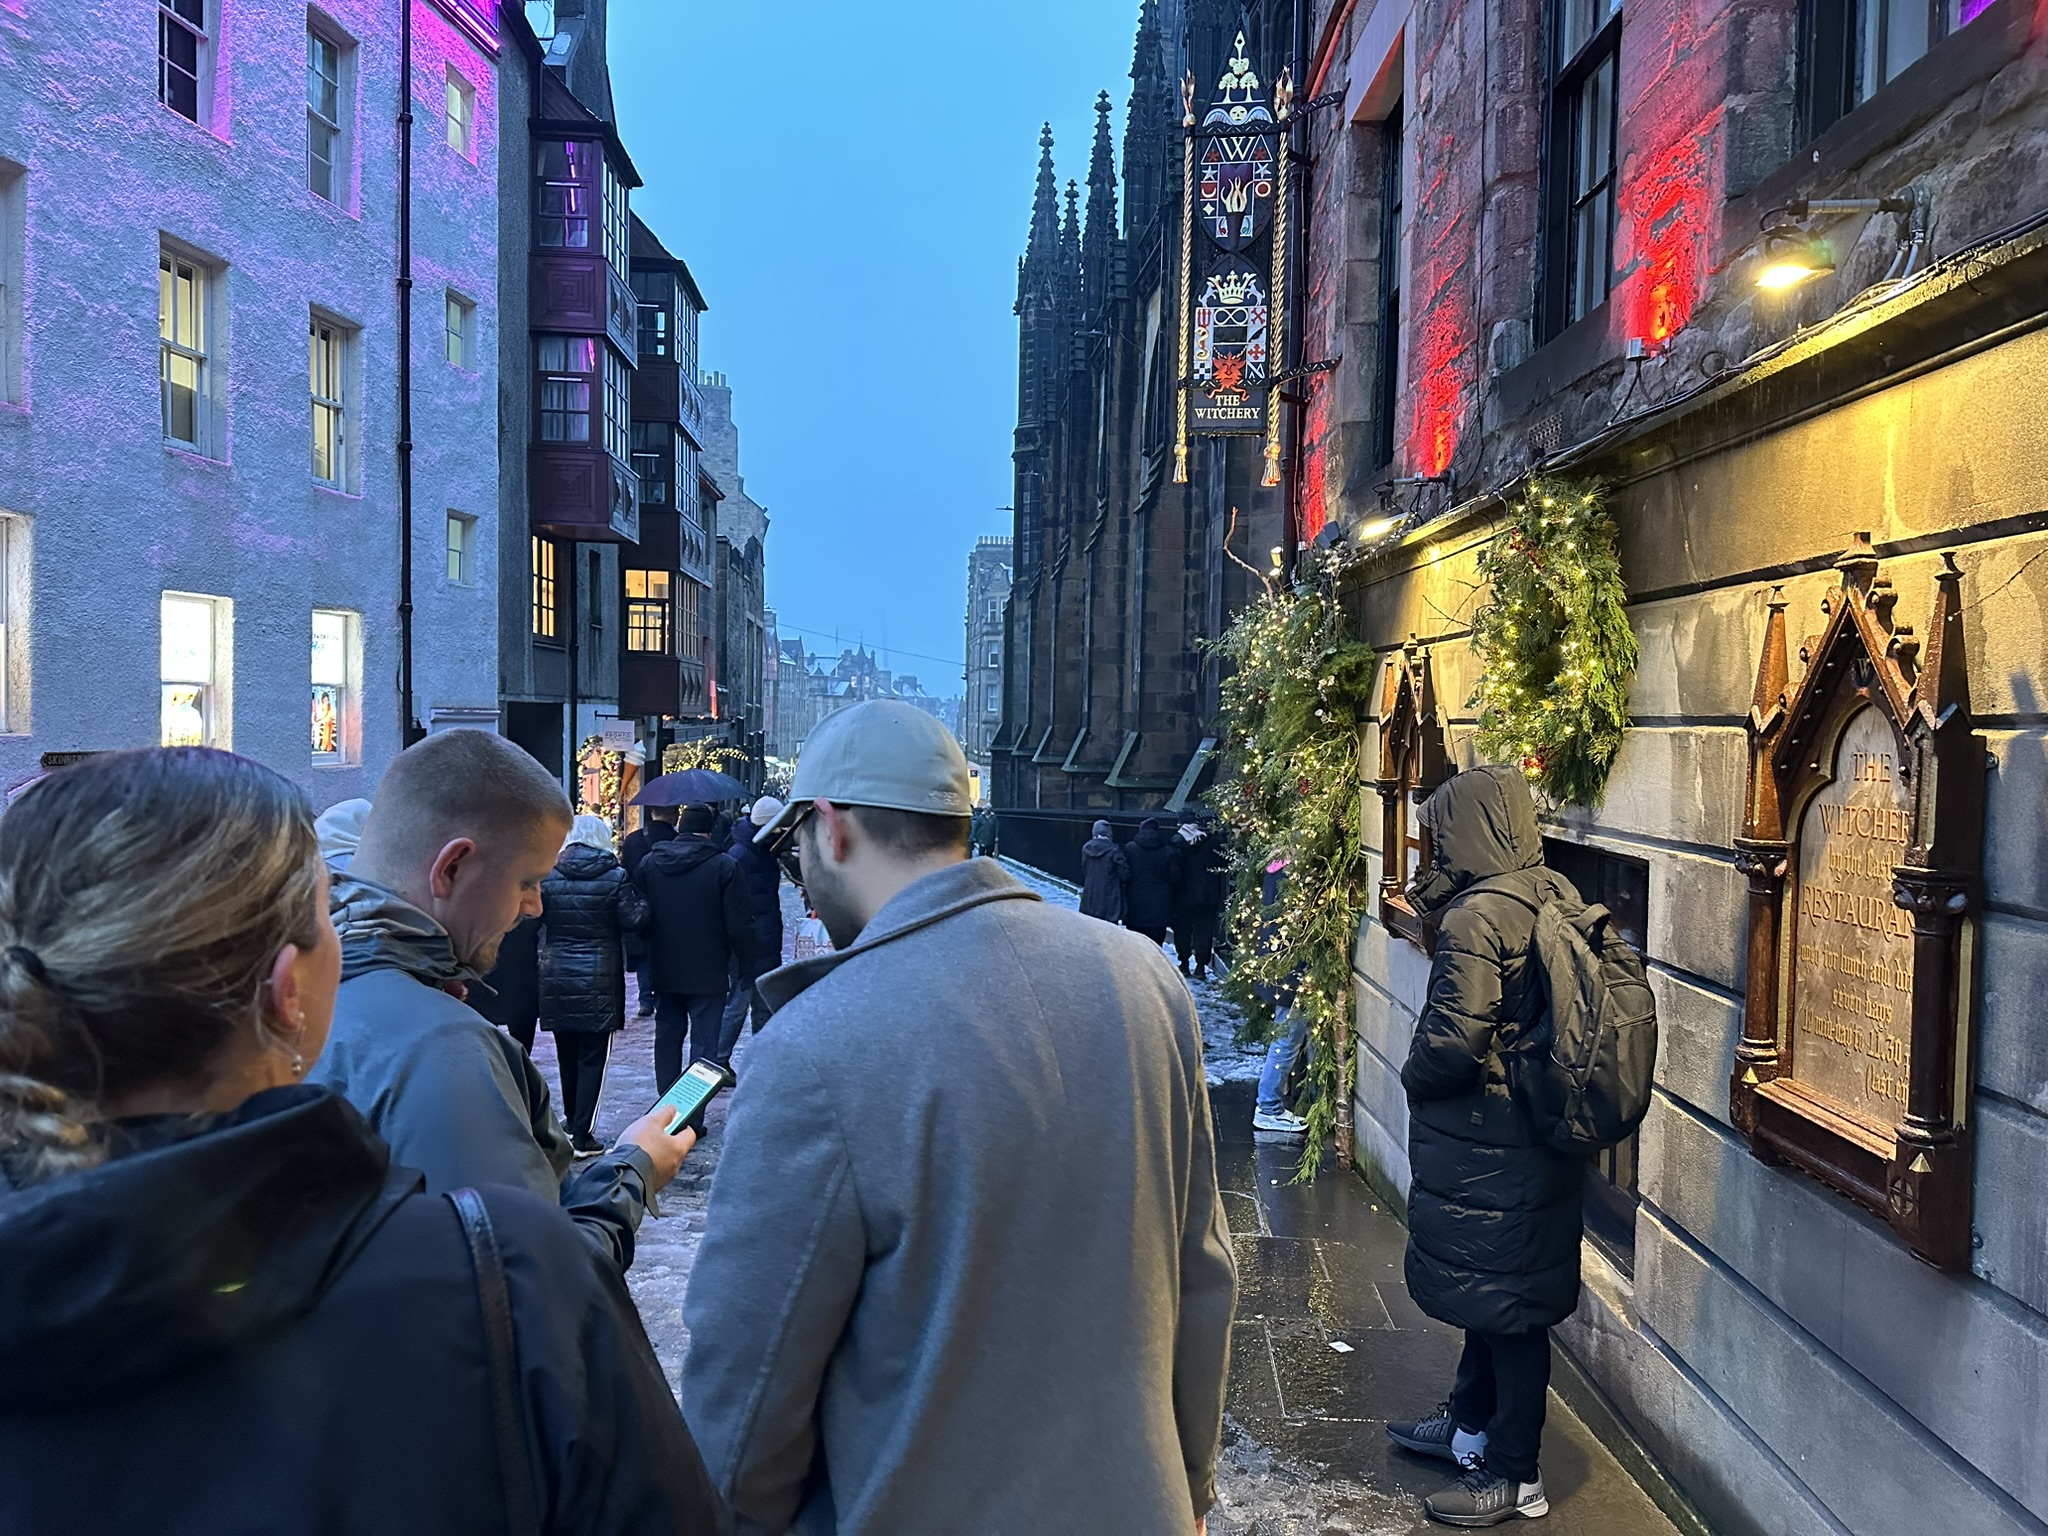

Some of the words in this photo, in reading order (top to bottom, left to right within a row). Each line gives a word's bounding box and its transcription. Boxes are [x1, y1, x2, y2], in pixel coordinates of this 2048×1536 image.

[1194, 407, 1261, 420] WITCHERY
[1215, 394, 1240, 407] THE
[47, 754, 83, 765] SKINNE
[1851, 751, 1892, 783] THE
[1818, 803, 1910, 846] WITCHER
[1828, 843, 1842, 883] by
[1844, 846, 1862, 876] the
[1801, 884, 1915, 942] RESTAURAN
[1822, 940, 1839, 971] for
[1840, 944, 1868, 983] lunch
[1869, 955, 1891, 988] and
